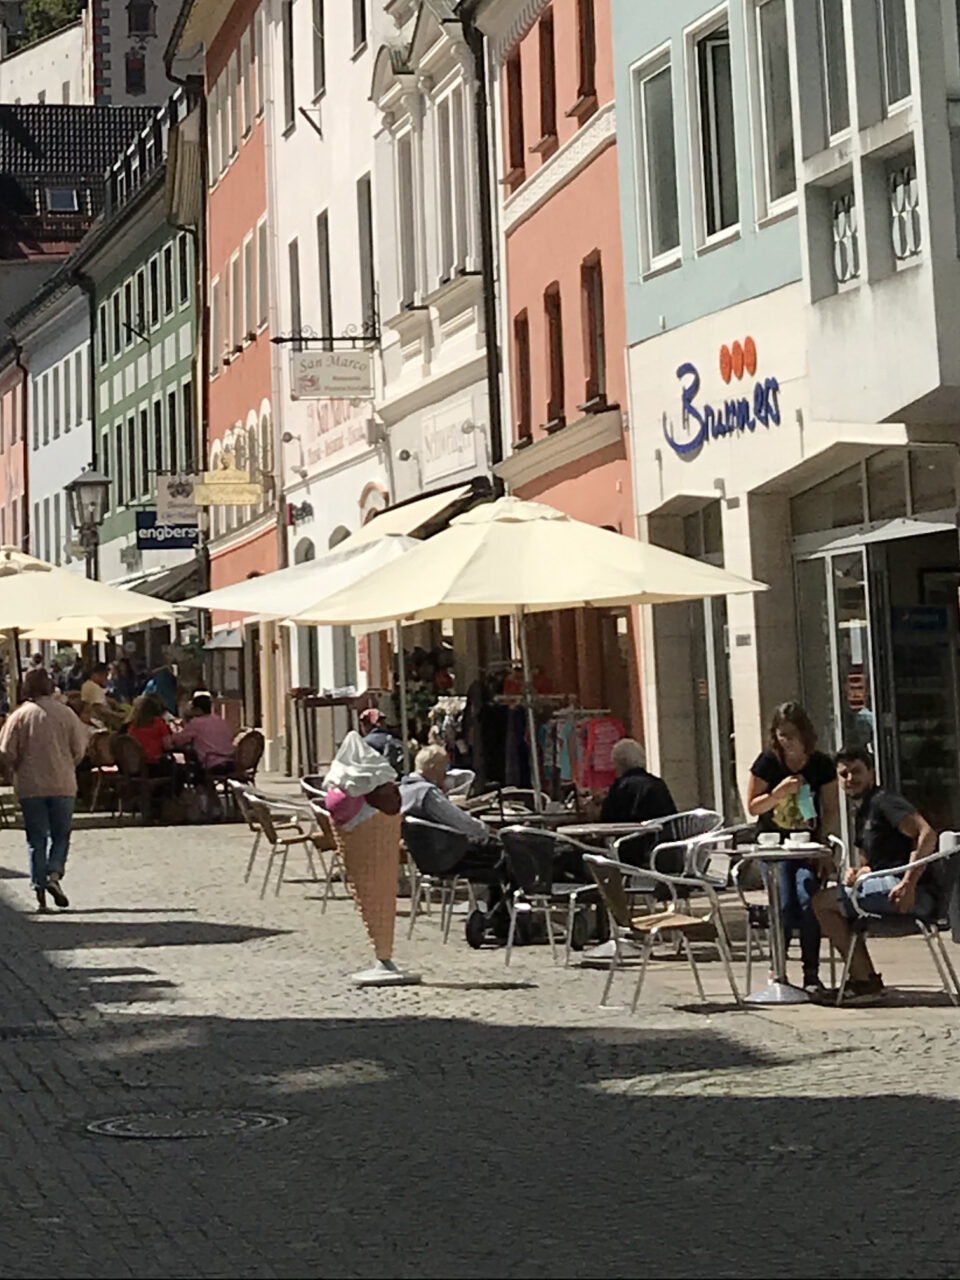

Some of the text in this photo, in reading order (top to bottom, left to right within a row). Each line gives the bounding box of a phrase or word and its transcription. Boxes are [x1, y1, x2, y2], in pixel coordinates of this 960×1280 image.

[299, 354, 368, 373] San Marco
[138, 525, 197, 541] engbers
